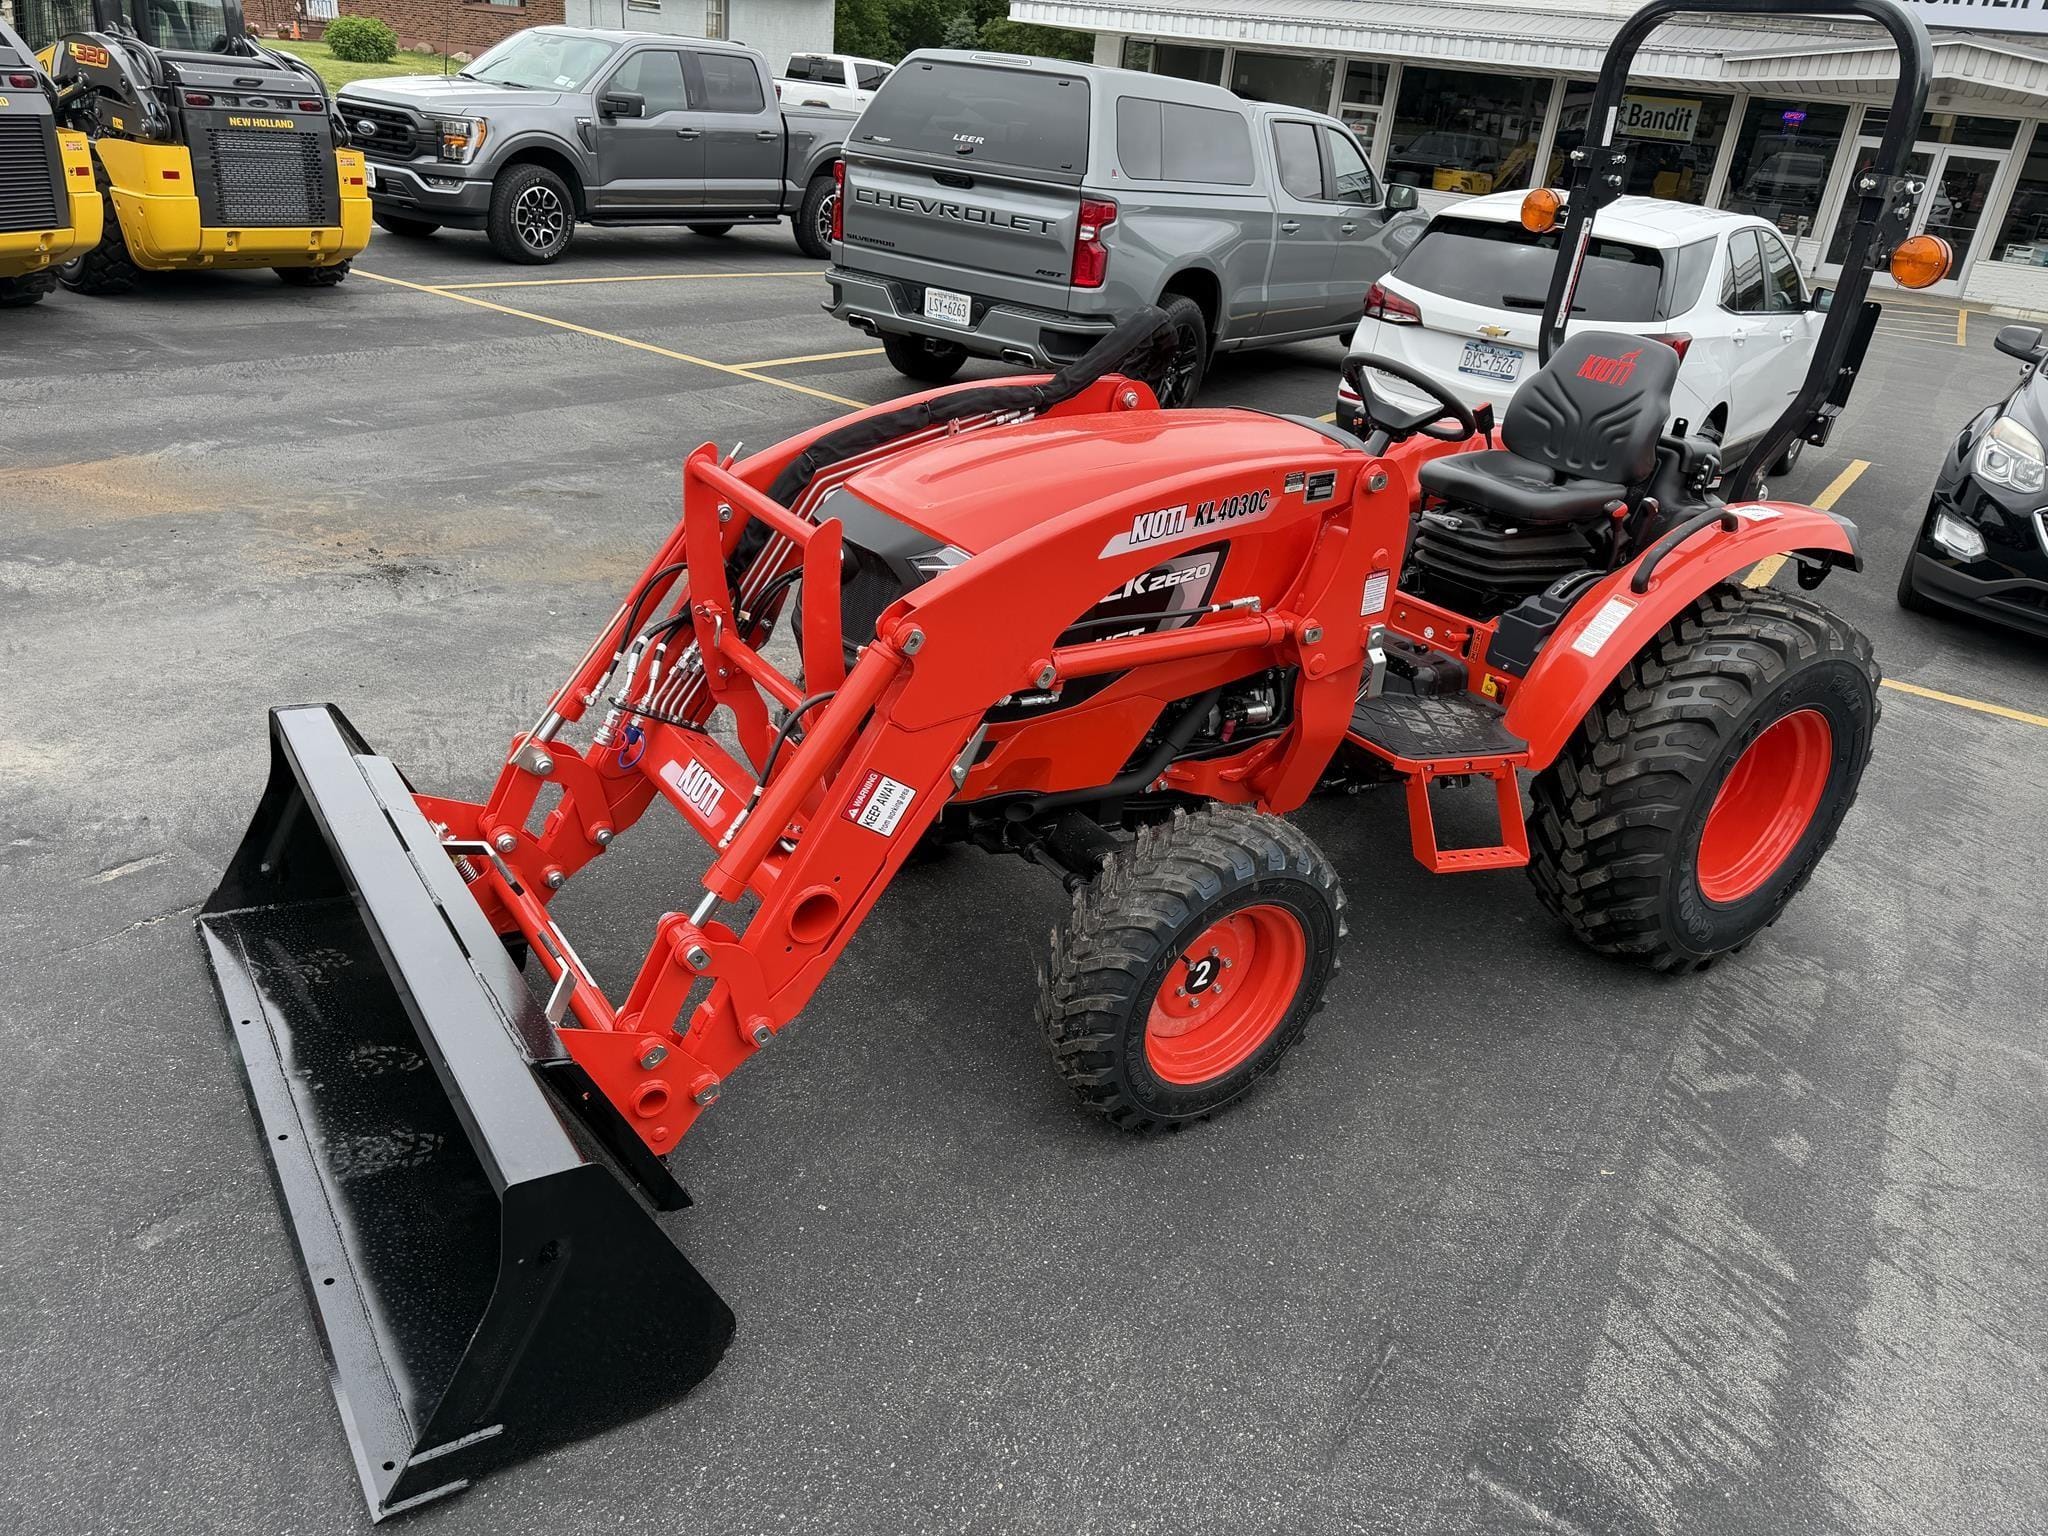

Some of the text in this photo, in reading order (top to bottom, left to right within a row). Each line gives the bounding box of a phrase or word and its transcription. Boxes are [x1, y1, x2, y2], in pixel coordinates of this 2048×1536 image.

[229, 117, 294, 129] NEW HOLLAND
[1628, 104, 1693, 132] Bandit
[952, 133, 985, 145] LEER
[855, 188, 1057, 236] CHEVROLET
[846, 233, 895, 248] SILVERADO
[1035, 268, 1066, 278] RST
[1577, 350, 1639, 386] KIOTI
[1129, 488, 1272, 544] KIOTI KL4030C
[676, 757, 727, 818] KIOTI
[852, 773, 879, 808] WARNING
[862, 780, 897, 828] KEEP AWAY
[1192, 960, 1212, 988] 2
